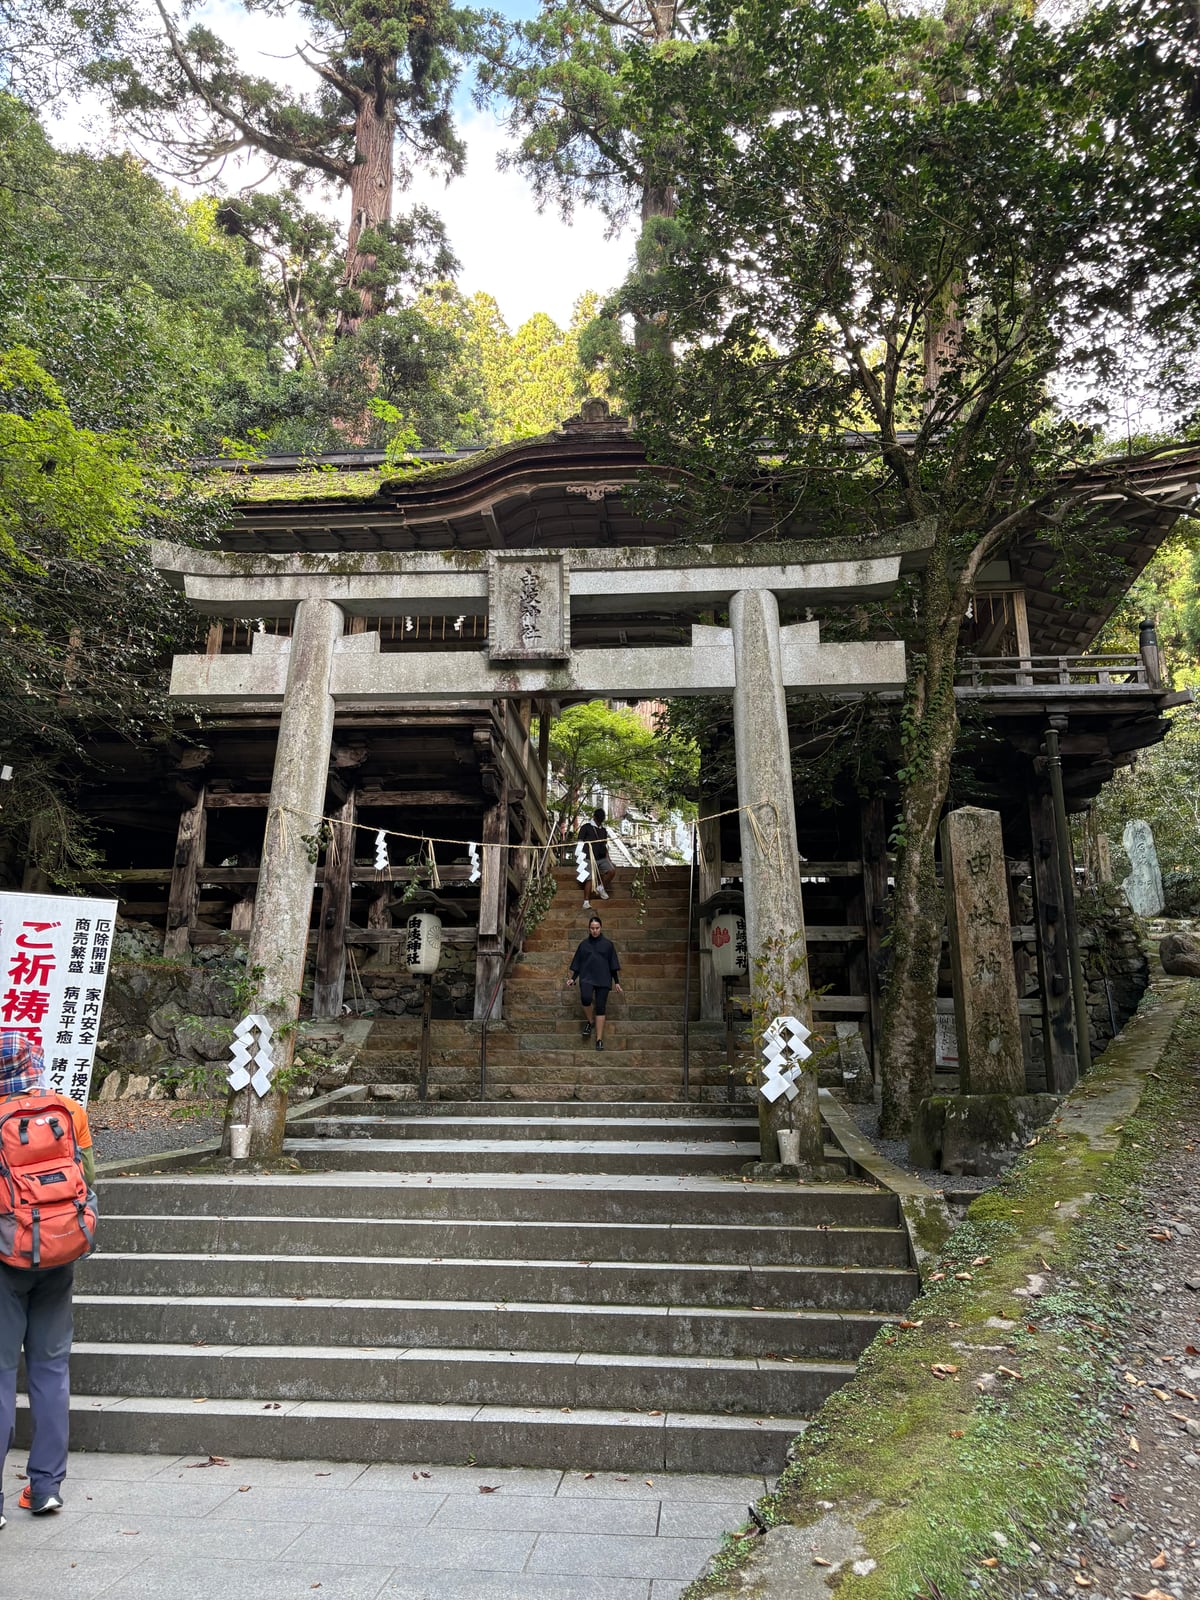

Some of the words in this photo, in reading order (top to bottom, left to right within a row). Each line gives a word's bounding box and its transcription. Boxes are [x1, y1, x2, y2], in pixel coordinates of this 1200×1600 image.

[68, 918, 91, 973] 商売繁盛
[89, 918, 112, 975] 厄除開運
[406, 916, 422, 966] 由岐神社
[966, 850, 1010, 1040] 由岐神社
[56, 986, 80, 1044] 病気平癒
[78, 987, 102, 1045] 家内安全
[50, 1058, 68, 1095] 諸々
[69, 1058, 91, 1106] 子授安
